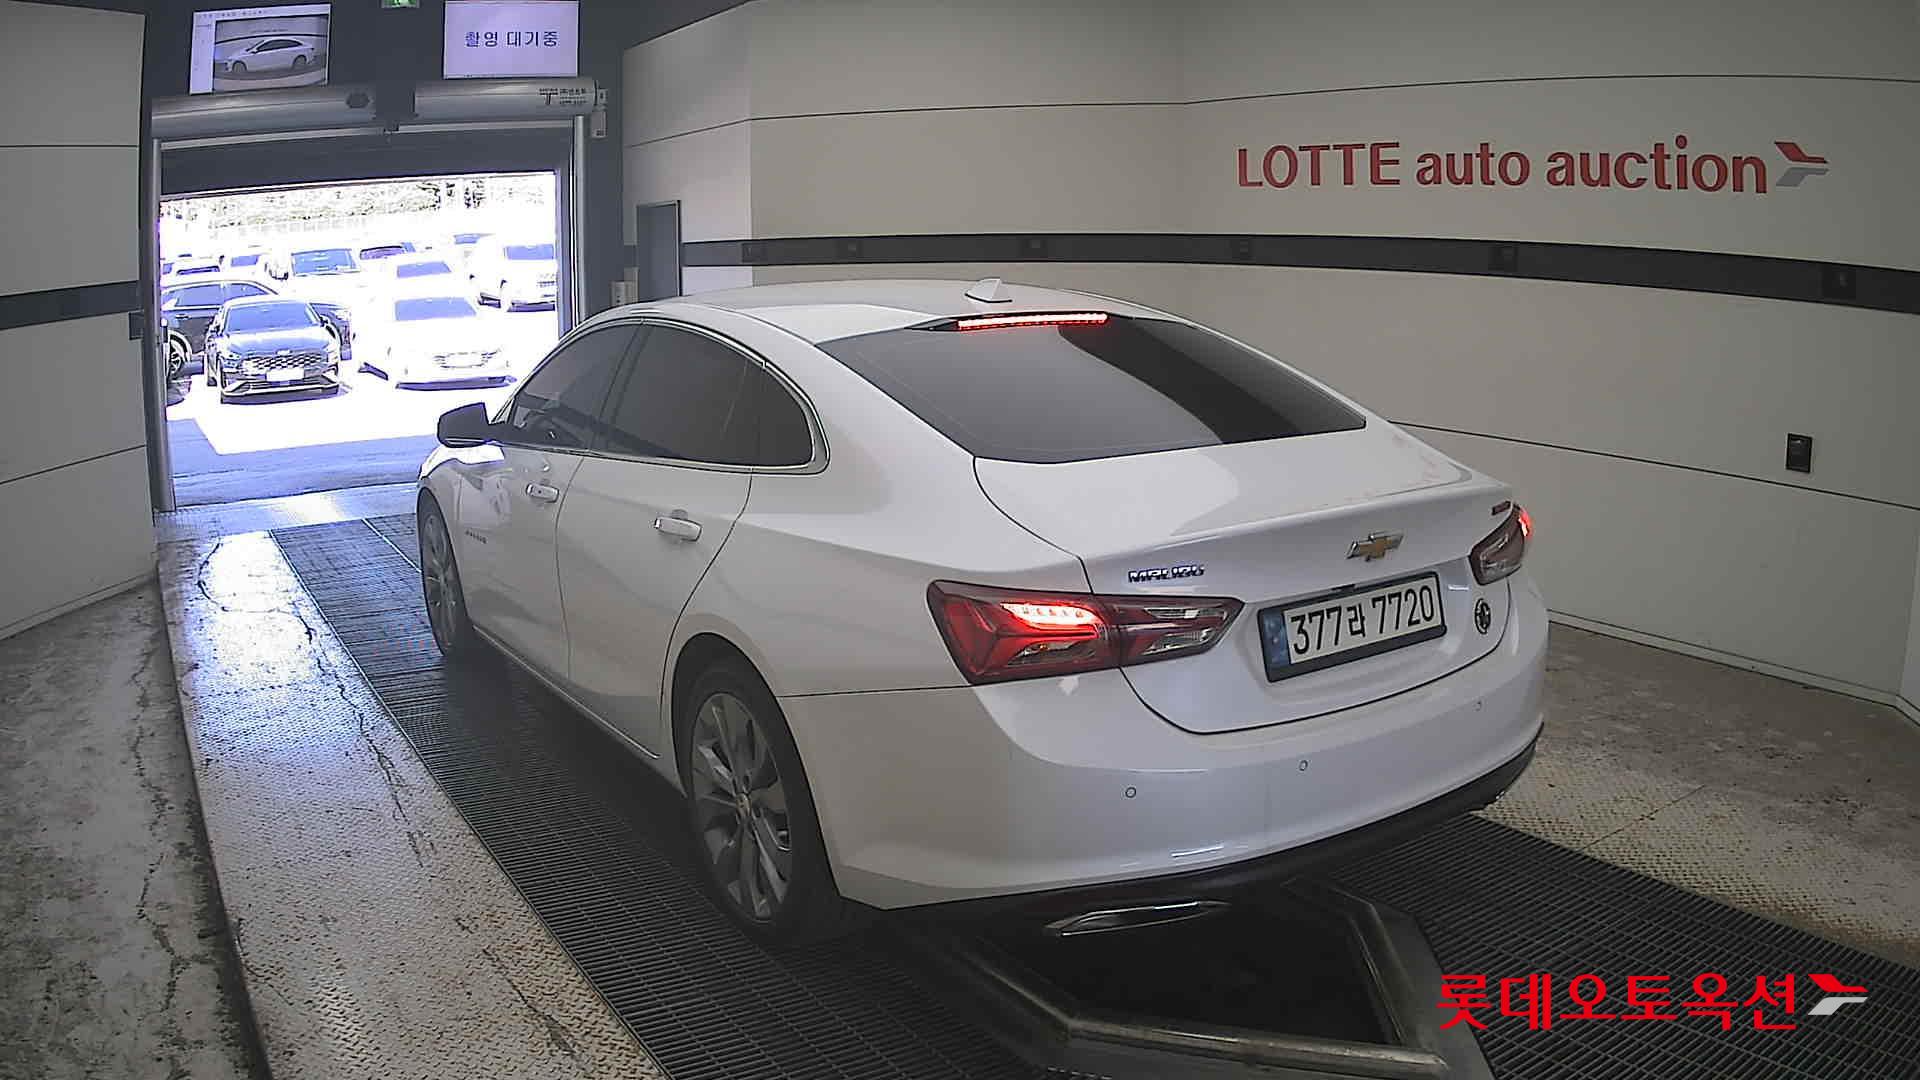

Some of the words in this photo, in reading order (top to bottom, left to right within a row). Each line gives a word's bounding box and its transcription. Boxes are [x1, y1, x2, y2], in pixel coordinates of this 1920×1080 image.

[507, 31, 560, 48] 대기중
[1238, 142, 1401, 188] LOTTE
[1415, 142, 1531, 187] auto
[1546, 134, 1768, 194] auction
[1290, 603, 1366, 655] 377라
[1371, 585, 1435, 634] 7720
